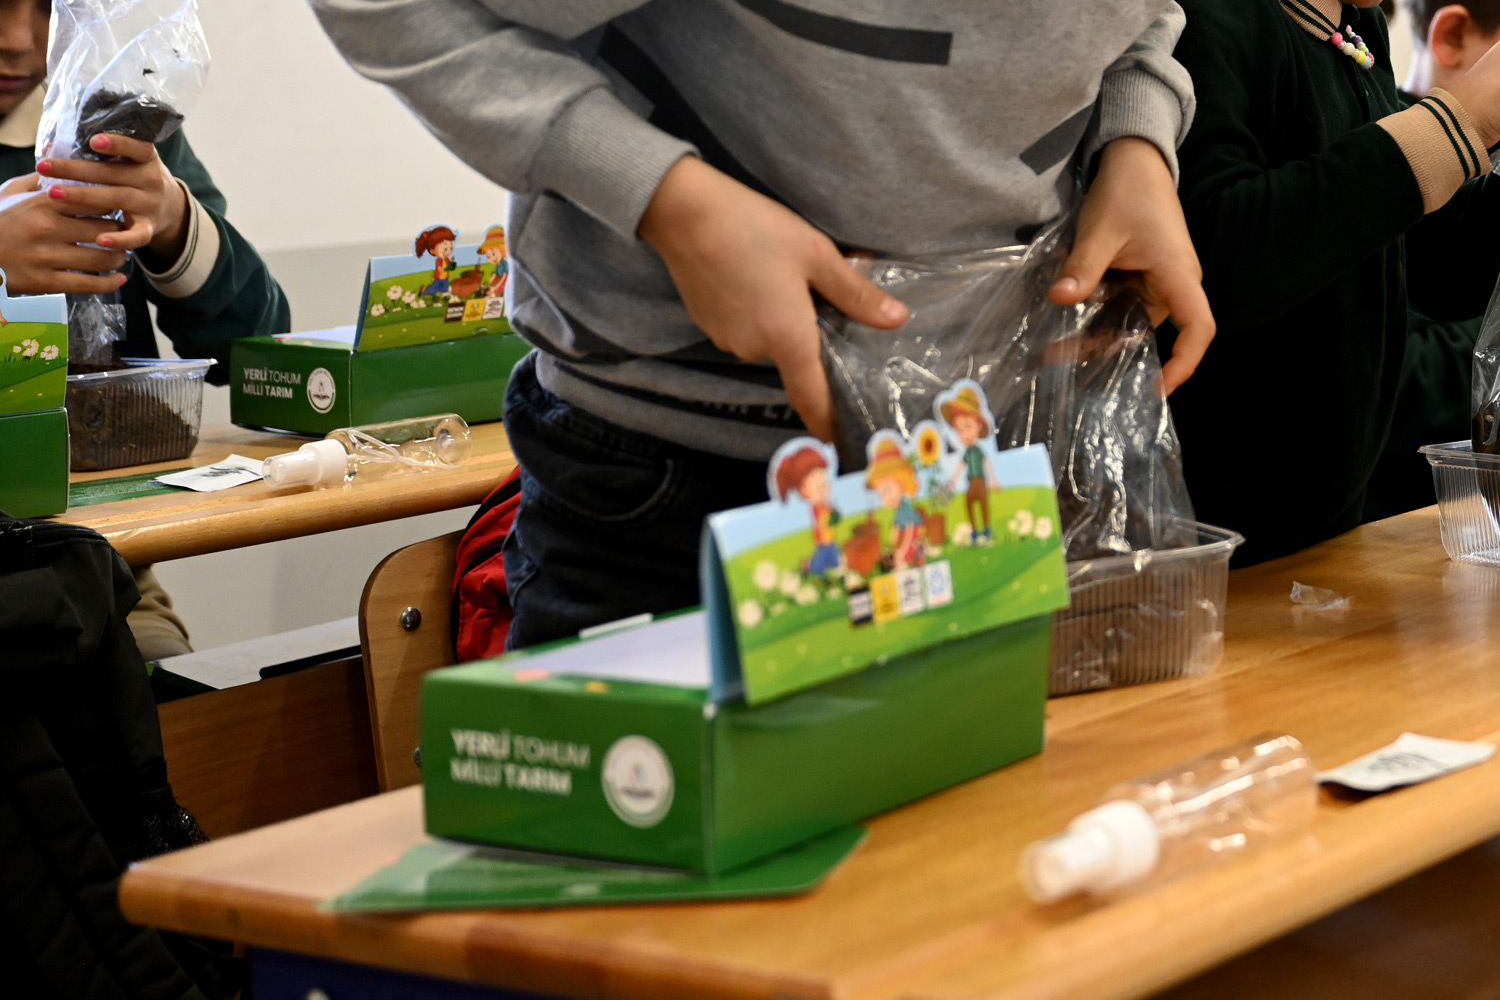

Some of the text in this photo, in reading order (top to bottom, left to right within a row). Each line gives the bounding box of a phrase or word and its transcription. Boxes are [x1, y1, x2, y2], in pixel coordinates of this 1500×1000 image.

[243, 366, 268, 382] YERLİ
[269, 370, 302, 385] TOHUM
[264, 385, 293, 399] TARIM
[450, 728, 591, 769] YERLİ TOHUM
[504, 762, 572, 796] TARIM
